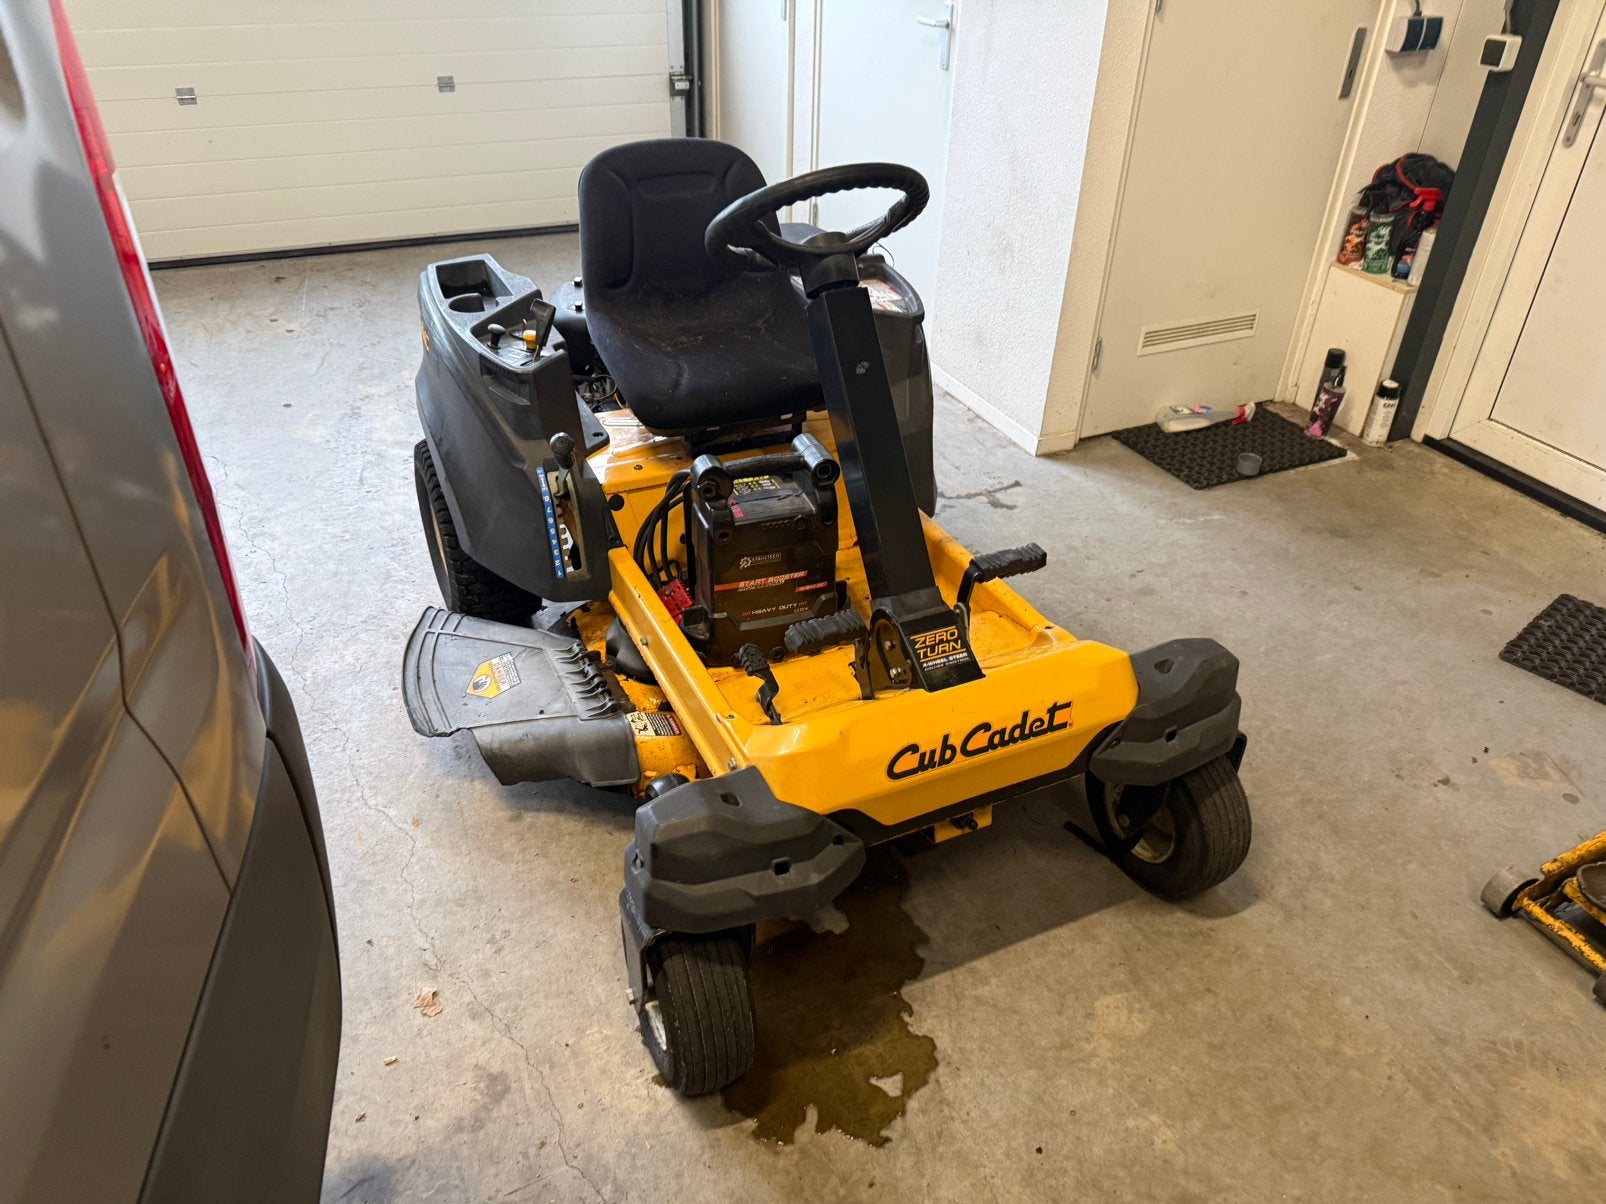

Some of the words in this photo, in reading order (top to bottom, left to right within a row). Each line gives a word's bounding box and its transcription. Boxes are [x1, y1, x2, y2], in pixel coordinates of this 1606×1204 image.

[738, 578, 767, 588] START
[767, 570, 807, 583] BOOSTER
[751, 607, 776, 615] HEAVY
[778, 602, 798, 611] DUTY
[915, 629, 958, 649] ZERO
[917, 639, 961, 659] TURN
[886, 733, 957, 781] Cub
[960, 701, 1073, 758] Cadet
